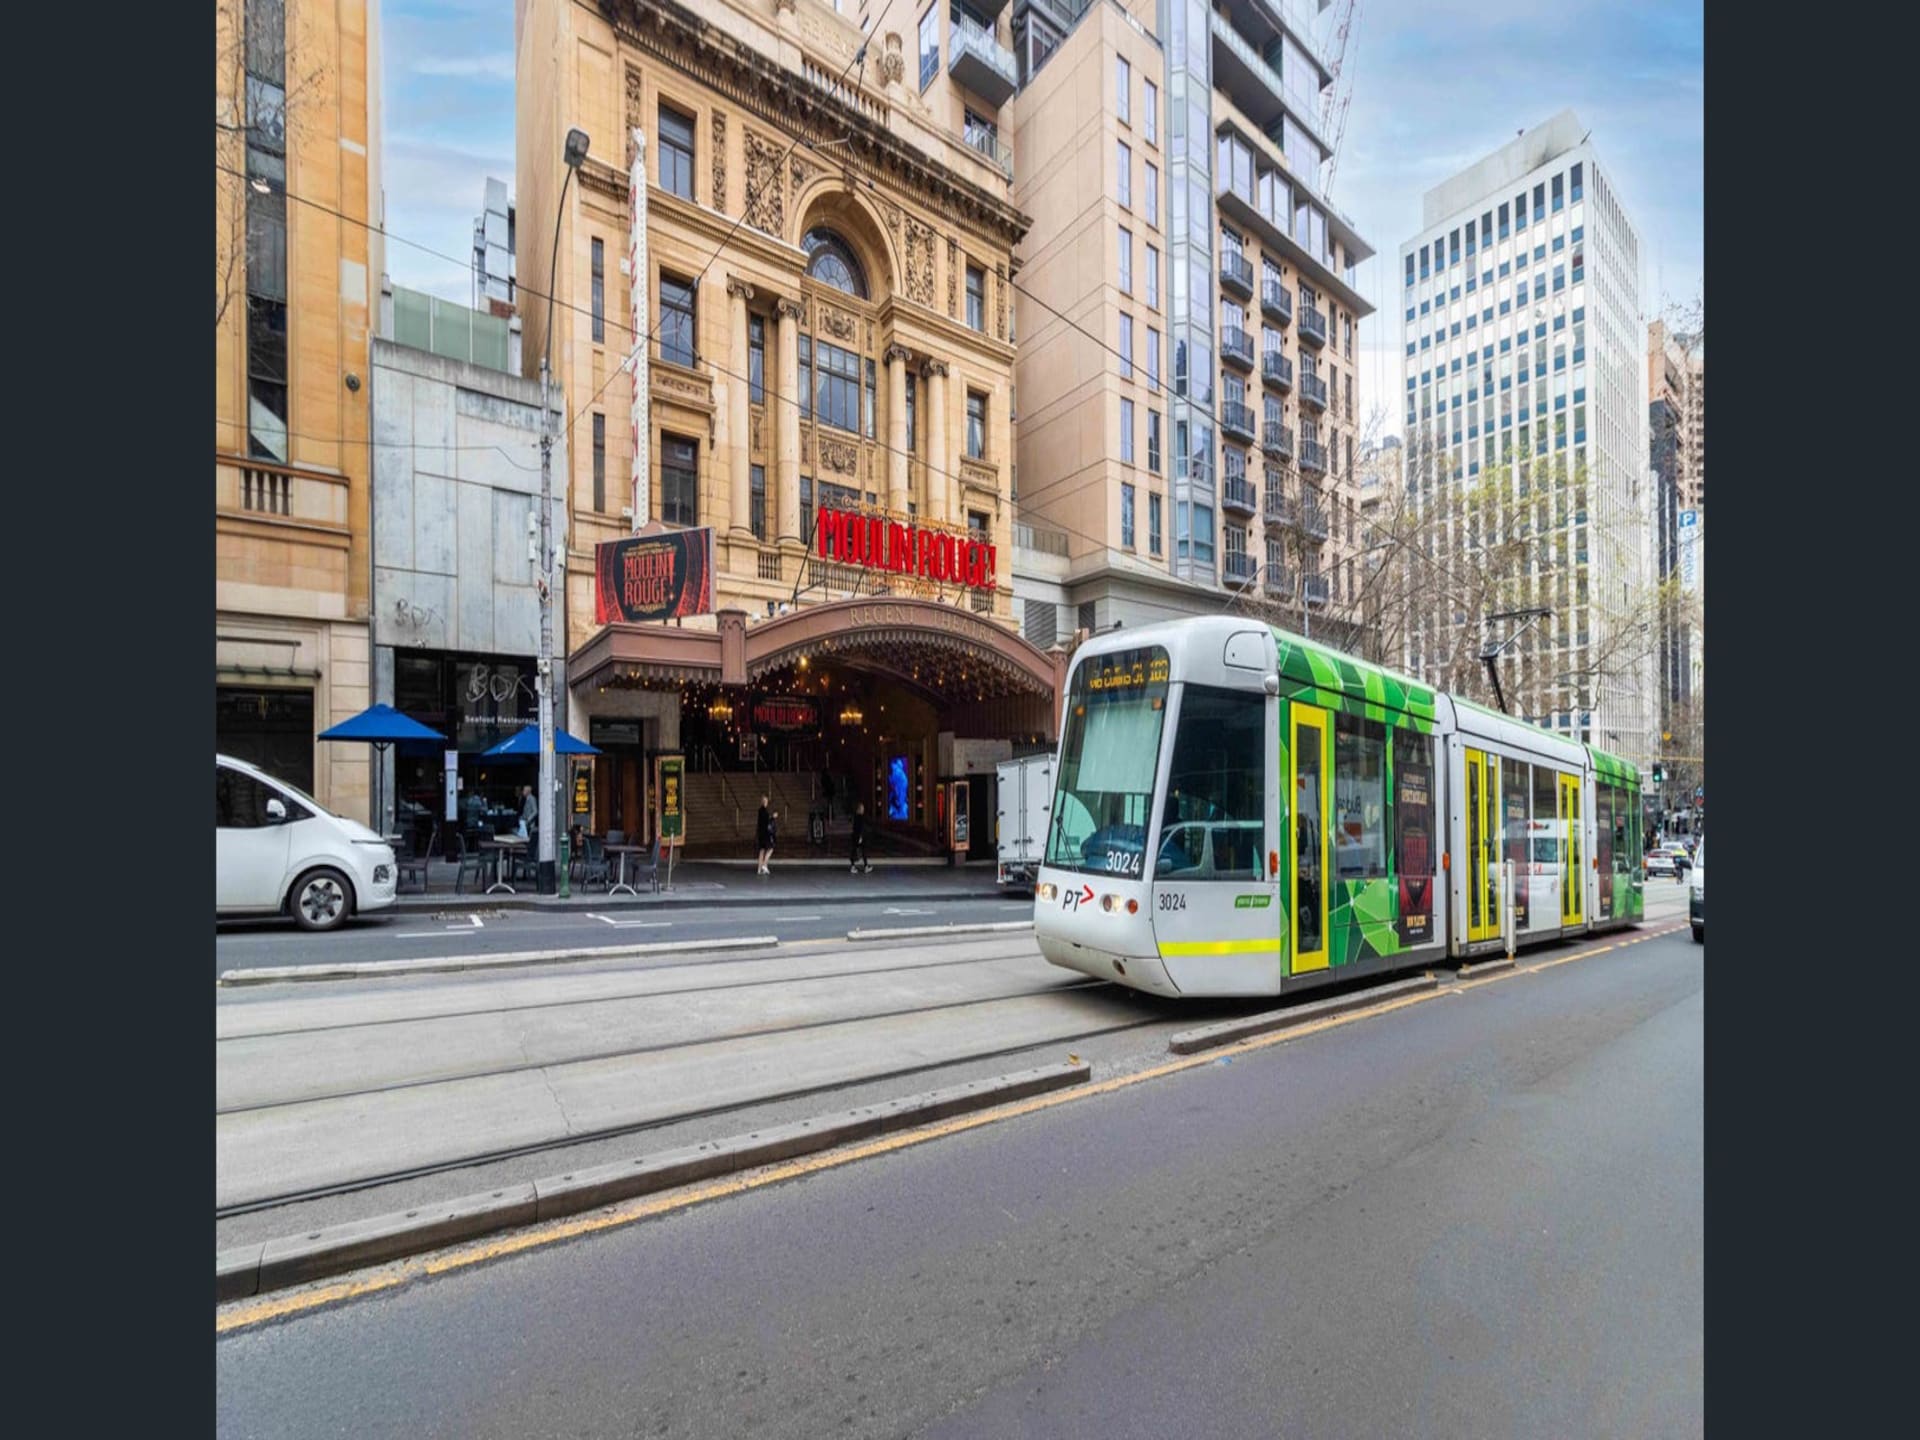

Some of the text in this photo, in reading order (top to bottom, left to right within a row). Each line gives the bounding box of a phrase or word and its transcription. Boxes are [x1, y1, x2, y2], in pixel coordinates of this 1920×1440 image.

[1683, 512, 1694, 527] P
[817, 506, 996, 590] MOULIN ROUGE!
[624, 552, 668, 582] MOULIN
[850, 605, 996, 642] REGENT THEATRE
[465, 715, 495, 724] Seafood
[1106, 850, 1140, 875] 3024
[1062, 889, 1084, 912] PT
[1159, 893, 1187, 911] 3024
